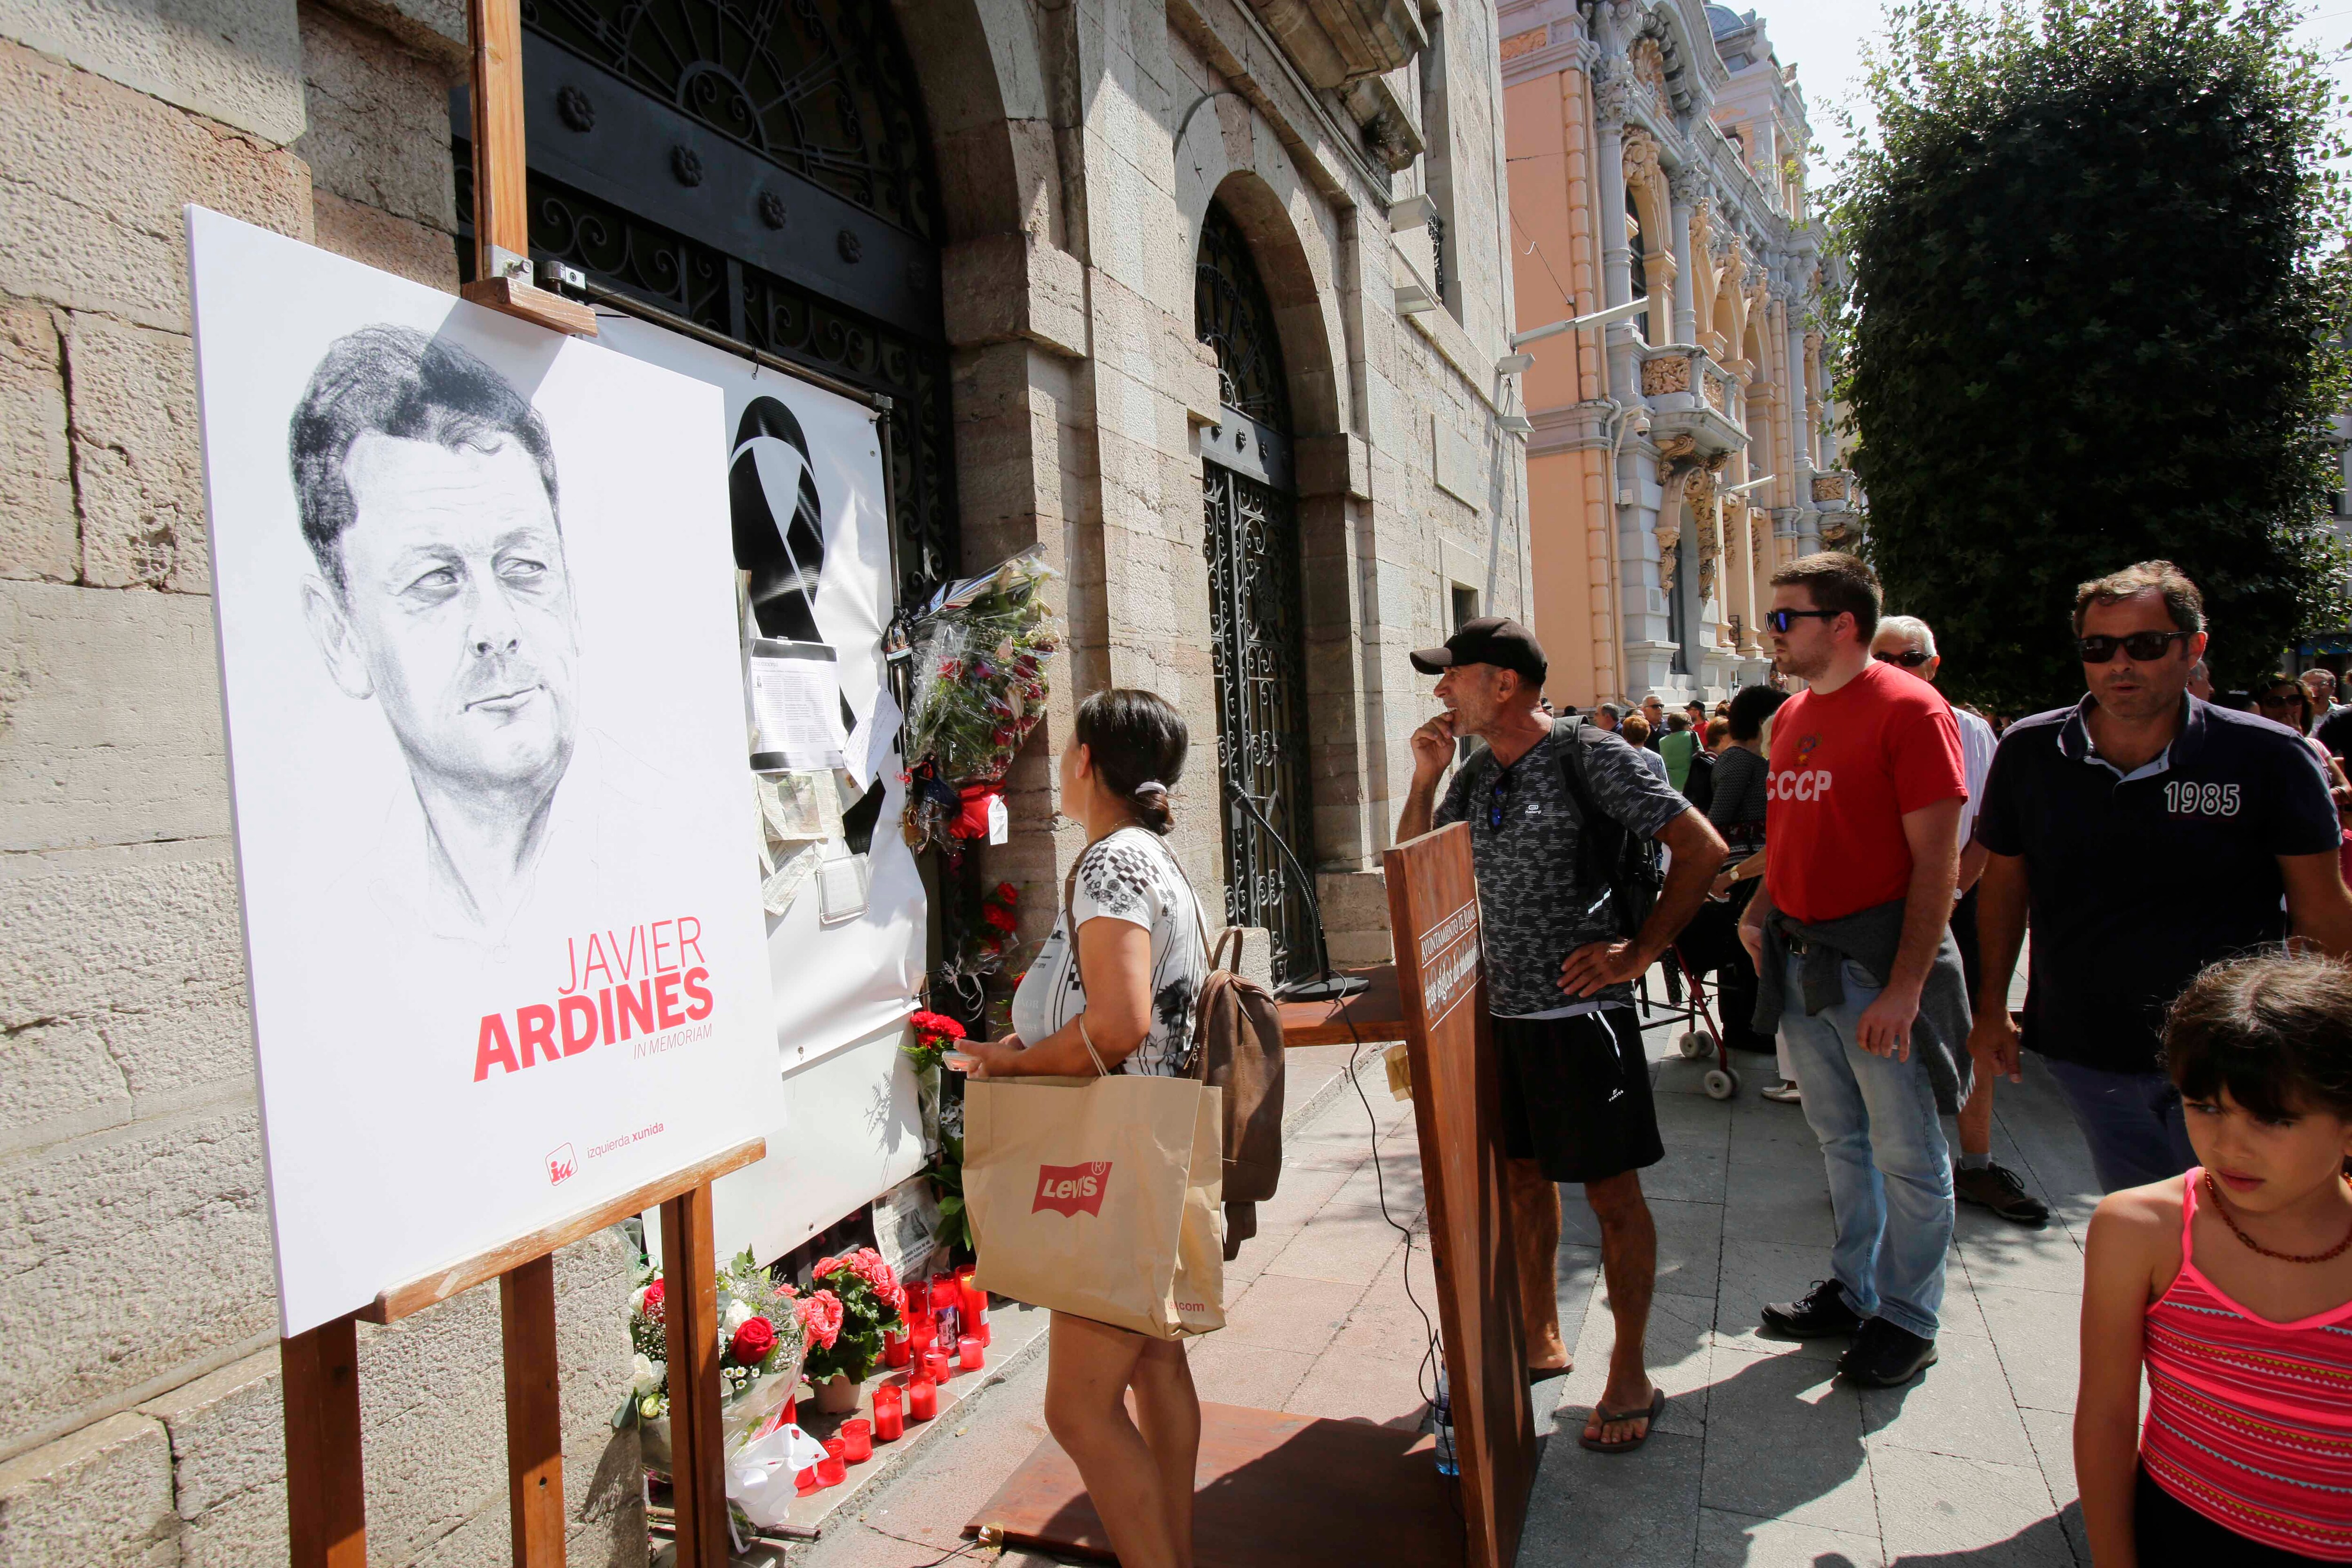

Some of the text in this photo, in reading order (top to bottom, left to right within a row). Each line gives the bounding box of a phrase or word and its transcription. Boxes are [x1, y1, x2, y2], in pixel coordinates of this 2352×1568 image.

[2164, 781, 2241, 816] 1985
[558, 916, 705, 995] JAVIER
[1421, 918, 1459, 963] AYUNTAMIENTO
[473, 967, 714, 1082] ARDINES
[634, 1023, 713, 1059] IN MEMORIAM
[587, 1122, 664, 1159] izquierda xunida
